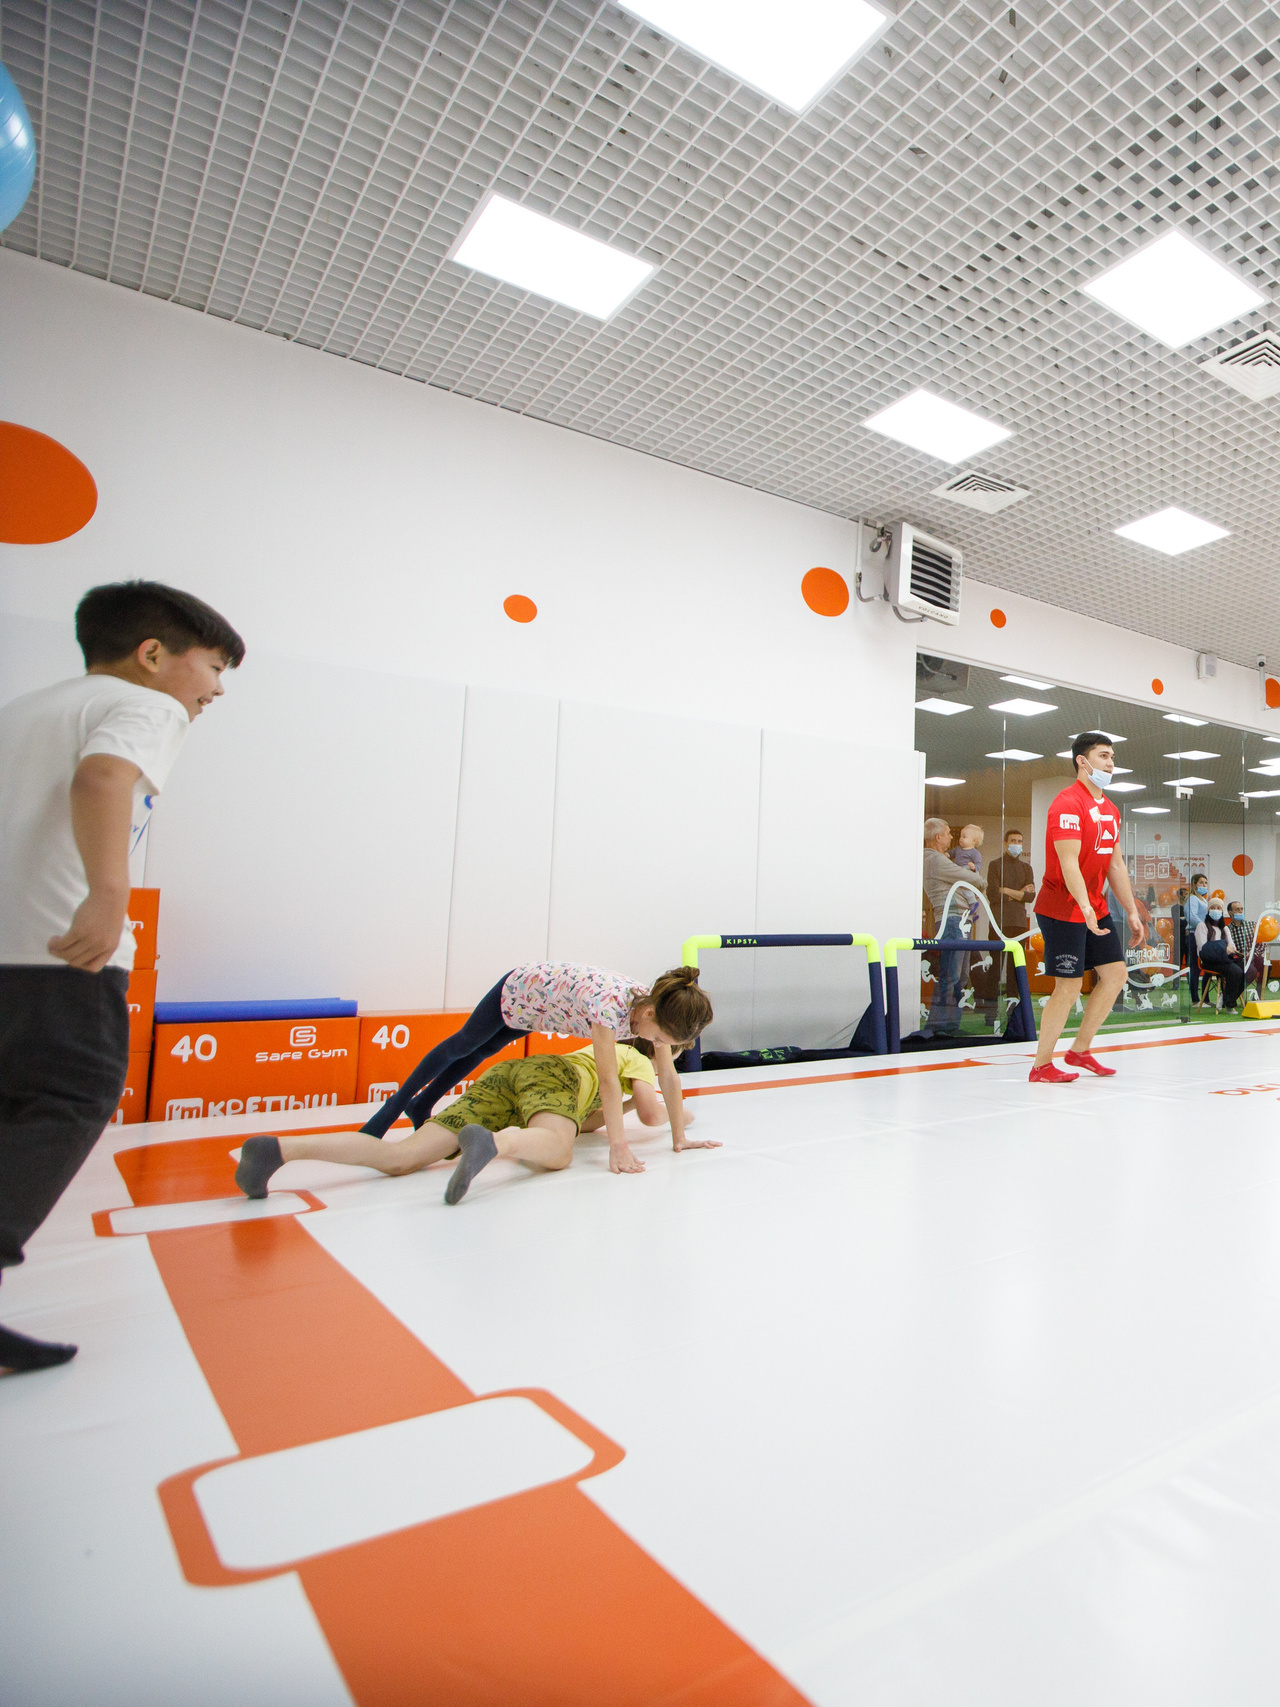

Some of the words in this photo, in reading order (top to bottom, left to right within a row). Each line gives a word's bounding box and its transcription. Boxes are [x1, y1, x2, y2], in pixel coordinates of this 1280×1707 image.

[918, 606, 949, 619] VOLCANO
[371, 1024, 410, 1050] 40
[170, 1034, 218, 1063] 40
[255, 1051, 303, 1063] Safe
[307, 1047, 348, 1059] Gym
